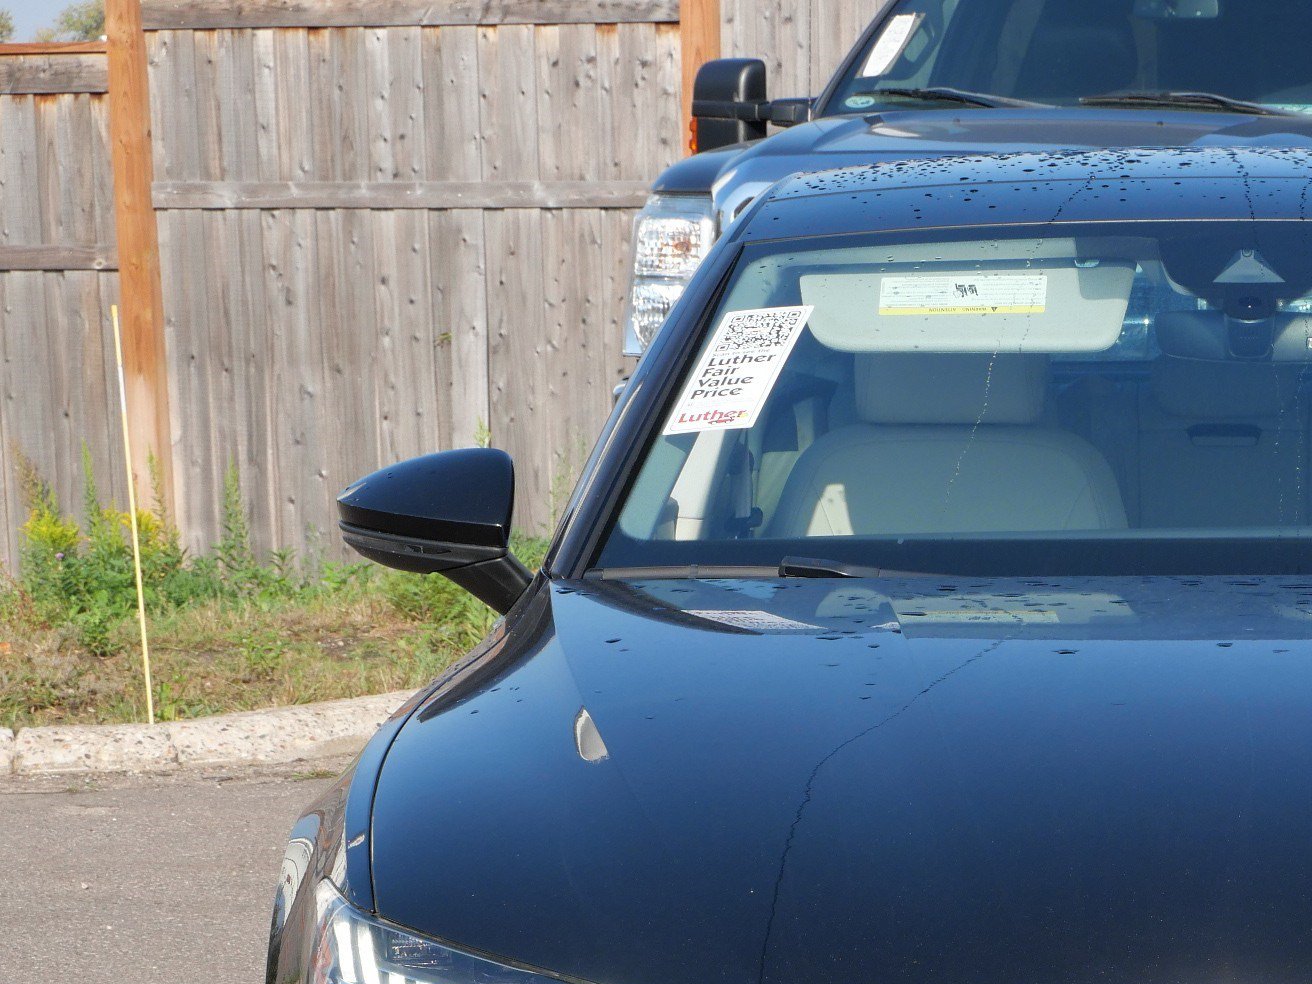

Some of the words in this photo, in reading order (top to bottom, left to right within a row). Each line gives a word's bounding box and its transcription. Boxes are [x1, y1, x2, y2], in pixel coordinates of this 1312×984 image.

[708, 354, 776, 367] Luther
[702, 366, 739, 377] Fair
[698, 376, 754, 387] Value
[691, 387, 743, 399] Price
[678, 409, 747, 423] Luther
